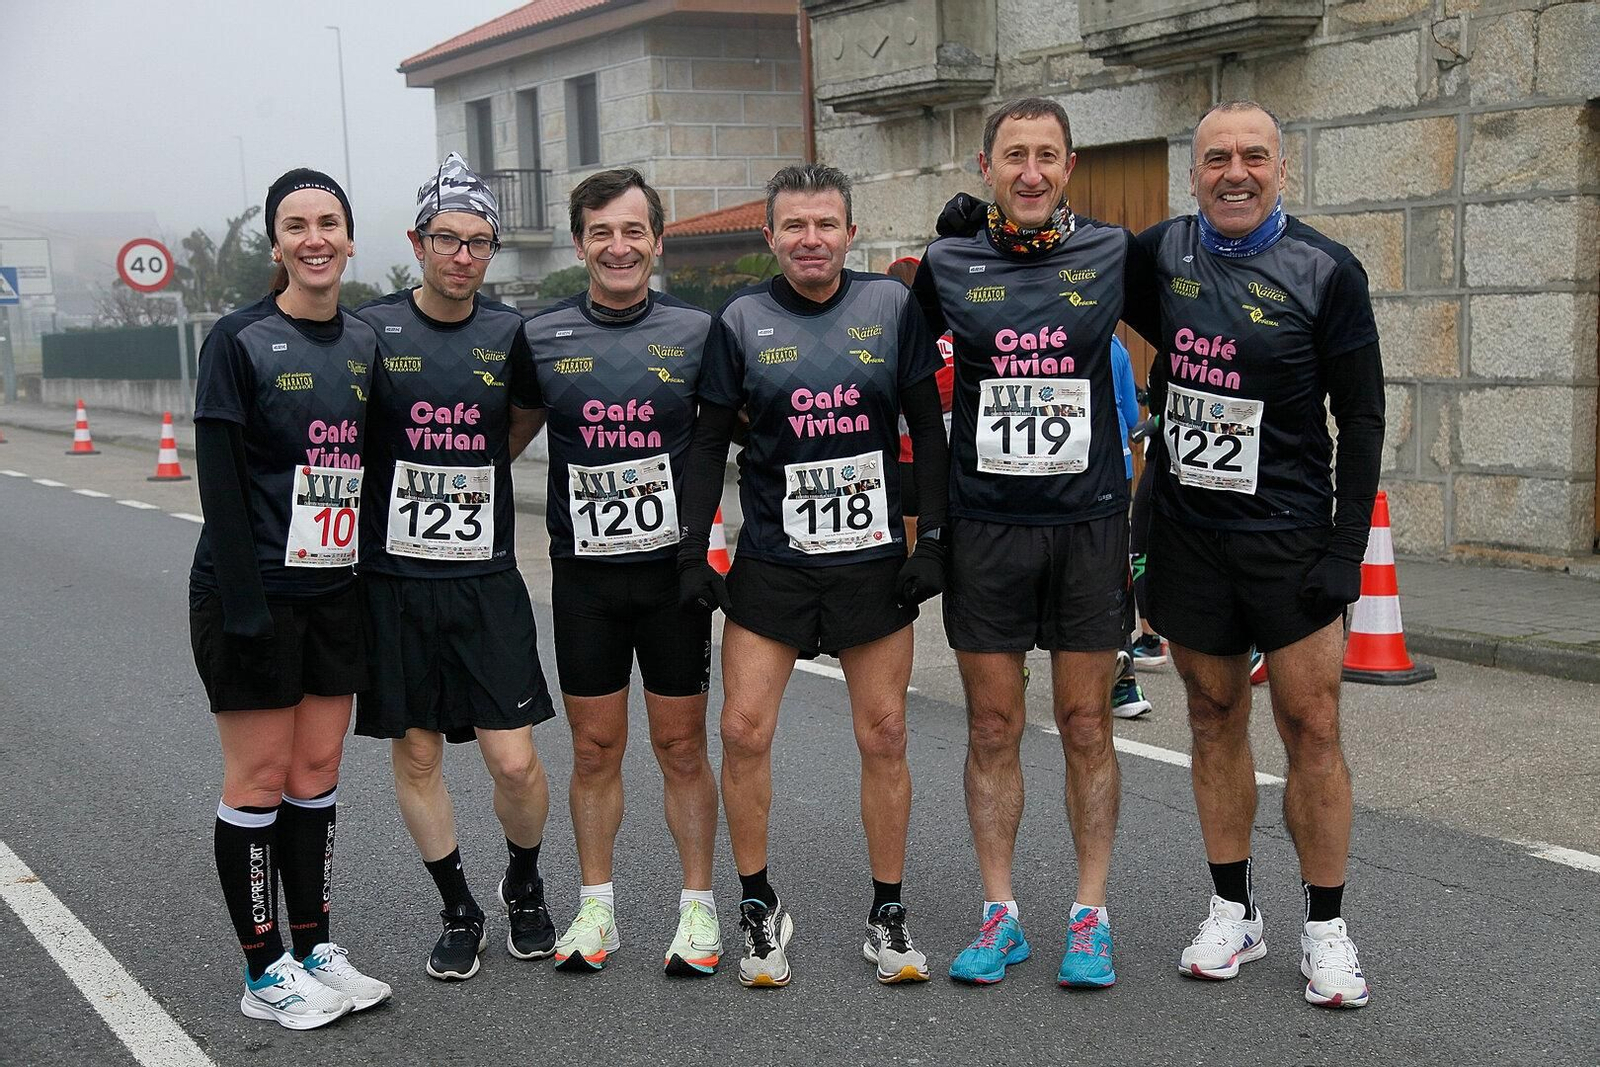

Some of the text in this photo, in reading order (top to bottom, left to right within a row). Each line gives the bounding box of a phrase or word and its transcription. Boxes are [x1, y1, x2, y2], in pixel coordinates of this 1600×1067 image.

[130, 257, 163, 273] 40
[1058, 269, 1097, 283] Nattex
[972, 289, 1005, 300] MARATON
[1248, 282, 1287, 302] Nattex
[847, 327, 883, 341] Nattex
[995, 326, 1068, 352] Café
[1174, 327, 1237, 361] Café
[389, 360, 422, 369] MARATON
[472, 348, 507, 363] Nattex
[648, 344, 685, 359] Nattex
[765, 349, 798, 362] MARATON
[560, 361, 594, 372] MARATON
[991, 352, 1075, 378] Vivian
[1169, 353, 1241, 390] Vivian
[282, 377, 313, 387] MARATON
[791, 383, 861, 411] Café
[991, 384, 1032, 413] XXI
[1170, 391, 1206, 427] XXI
[410, 400, 481, 425] Café
[582, 399, 655, 423] Café
[308, 419, 358, 444] Café
[405, 426, 486, 450] Vivian
[579, 424, 662, 449] Vivian
[788, 411, 870, 439] Vivian
[990, 416, 1071, 455] 119
[306, 446, 361, 469] Vivian
[1168, 424, 1243, 473] 122
[305, 473, 343, 503] XXI
[406, 468, 447, 500] XXI
[577, 470, 619, 498] XXI
[796, 466, 836, 496] XXI
[398, 500, 482, 542] 123
[577, 494, 664, 537] 120
[795, 492, 873, 535] 118
[314, 507, 356, 547] 10
[249, 845, 266, 923] COMPRESPORT
